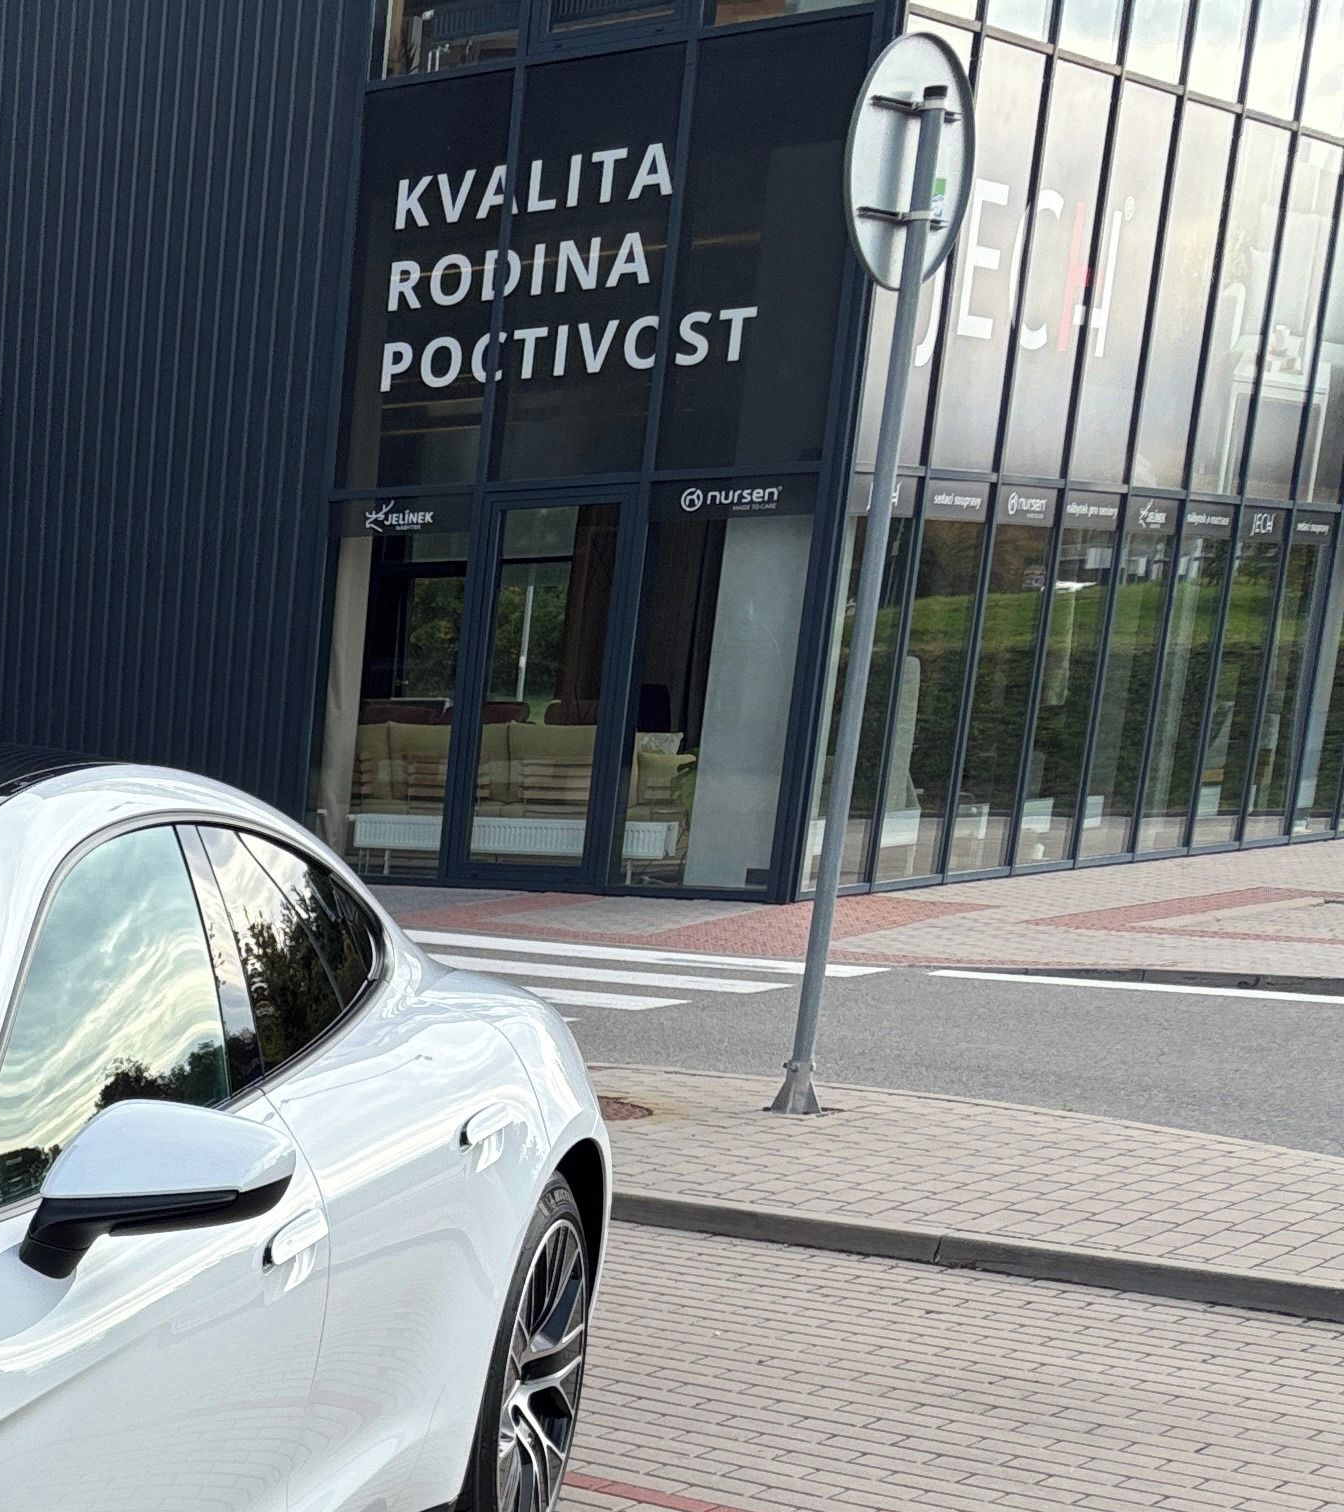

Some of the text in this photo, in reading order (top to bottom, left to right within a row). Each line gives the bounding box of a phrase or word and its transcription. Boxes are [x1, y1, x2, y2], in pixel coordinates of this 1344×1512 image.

[394, 142, 673, 231] KVALITA
[387, 231, 650, 312] RODINA
[379, 306, 759, 393] POCTIVOST
[384, 510, 433, 525] JELÍNEK
[707, 487, 778, 505] nursen
